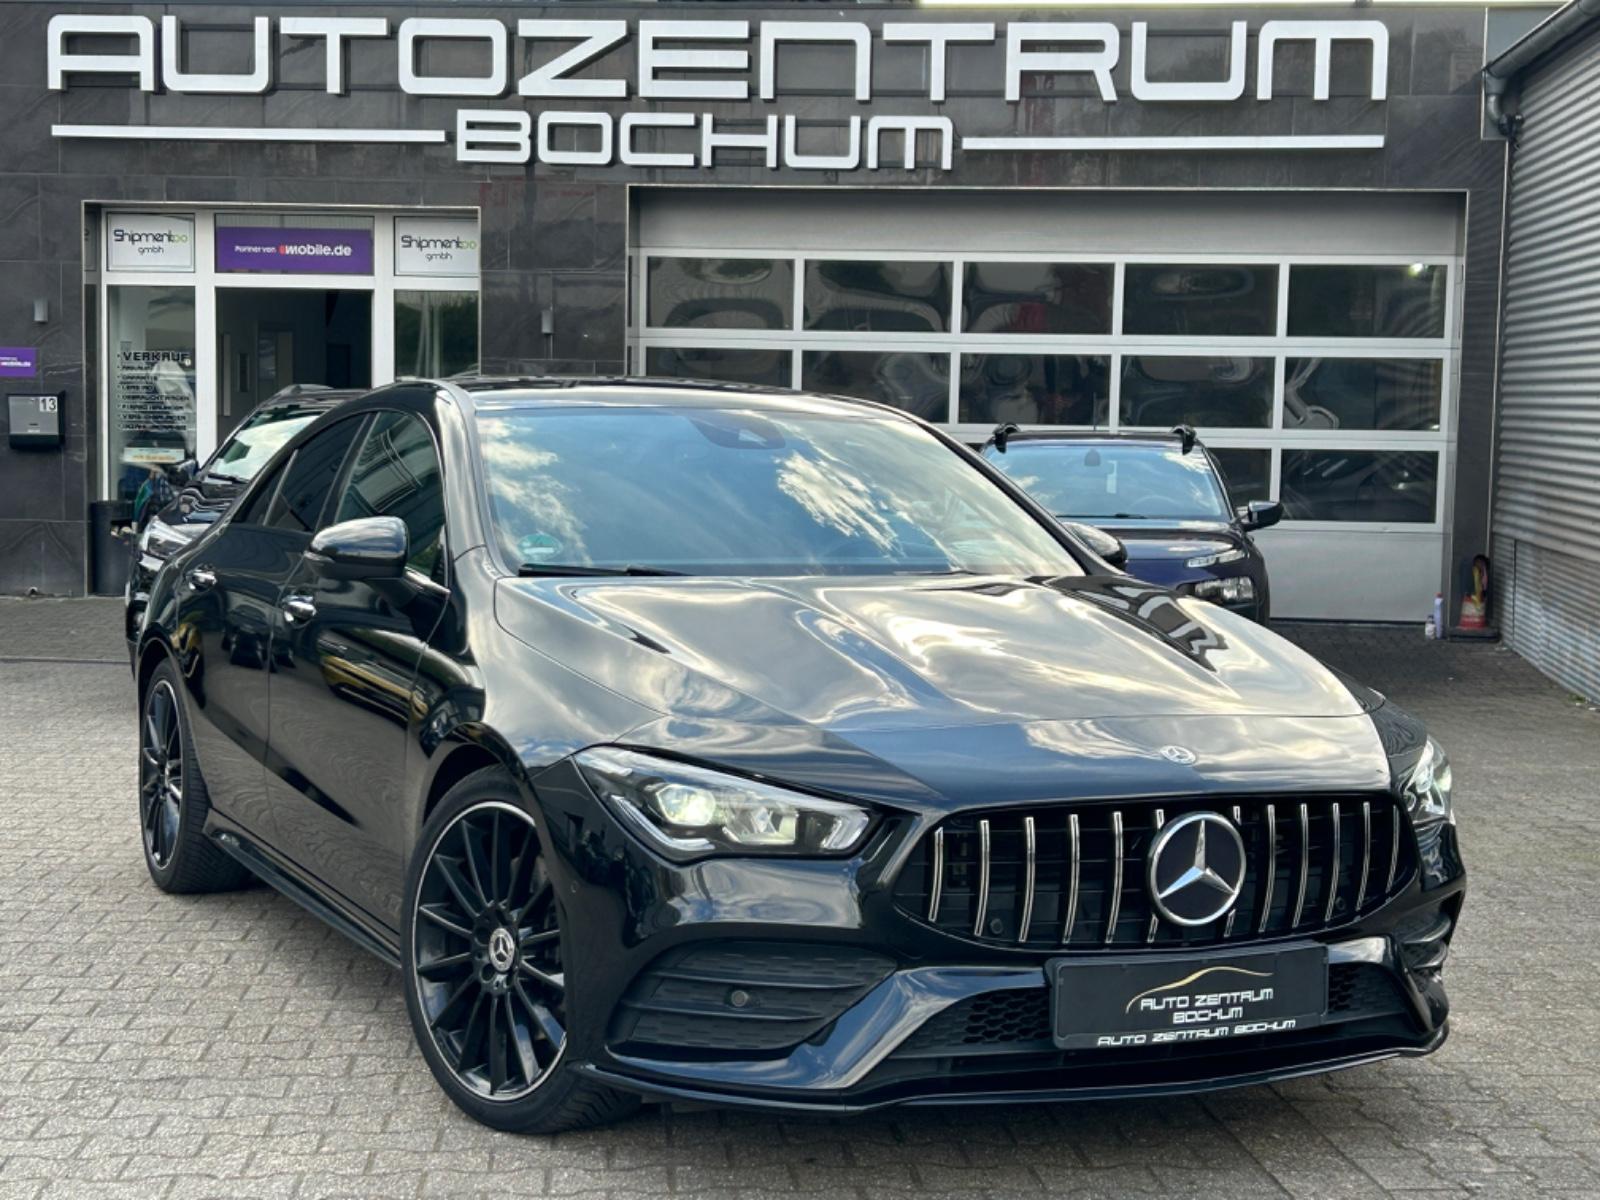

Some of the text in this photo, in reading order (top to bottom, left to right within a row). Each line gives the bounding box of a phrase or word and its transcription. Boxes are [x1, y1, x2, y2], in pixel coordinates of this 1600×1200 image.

[47, 14, 1389, 101] AUTOZENTRUM
[456, 108, 953, 170] BOCHUM
[123, 351, 189, 362] VERKAUF
[41, 398, 57, 411] 13
[1140, 987, 1274, 1012] AUTO ZENTRUM
[1172, 1006, 1243, 1025] BOCHUM
[1096, 1018, 1296, 1047] AUTO ZENTRUM BOCHUM
